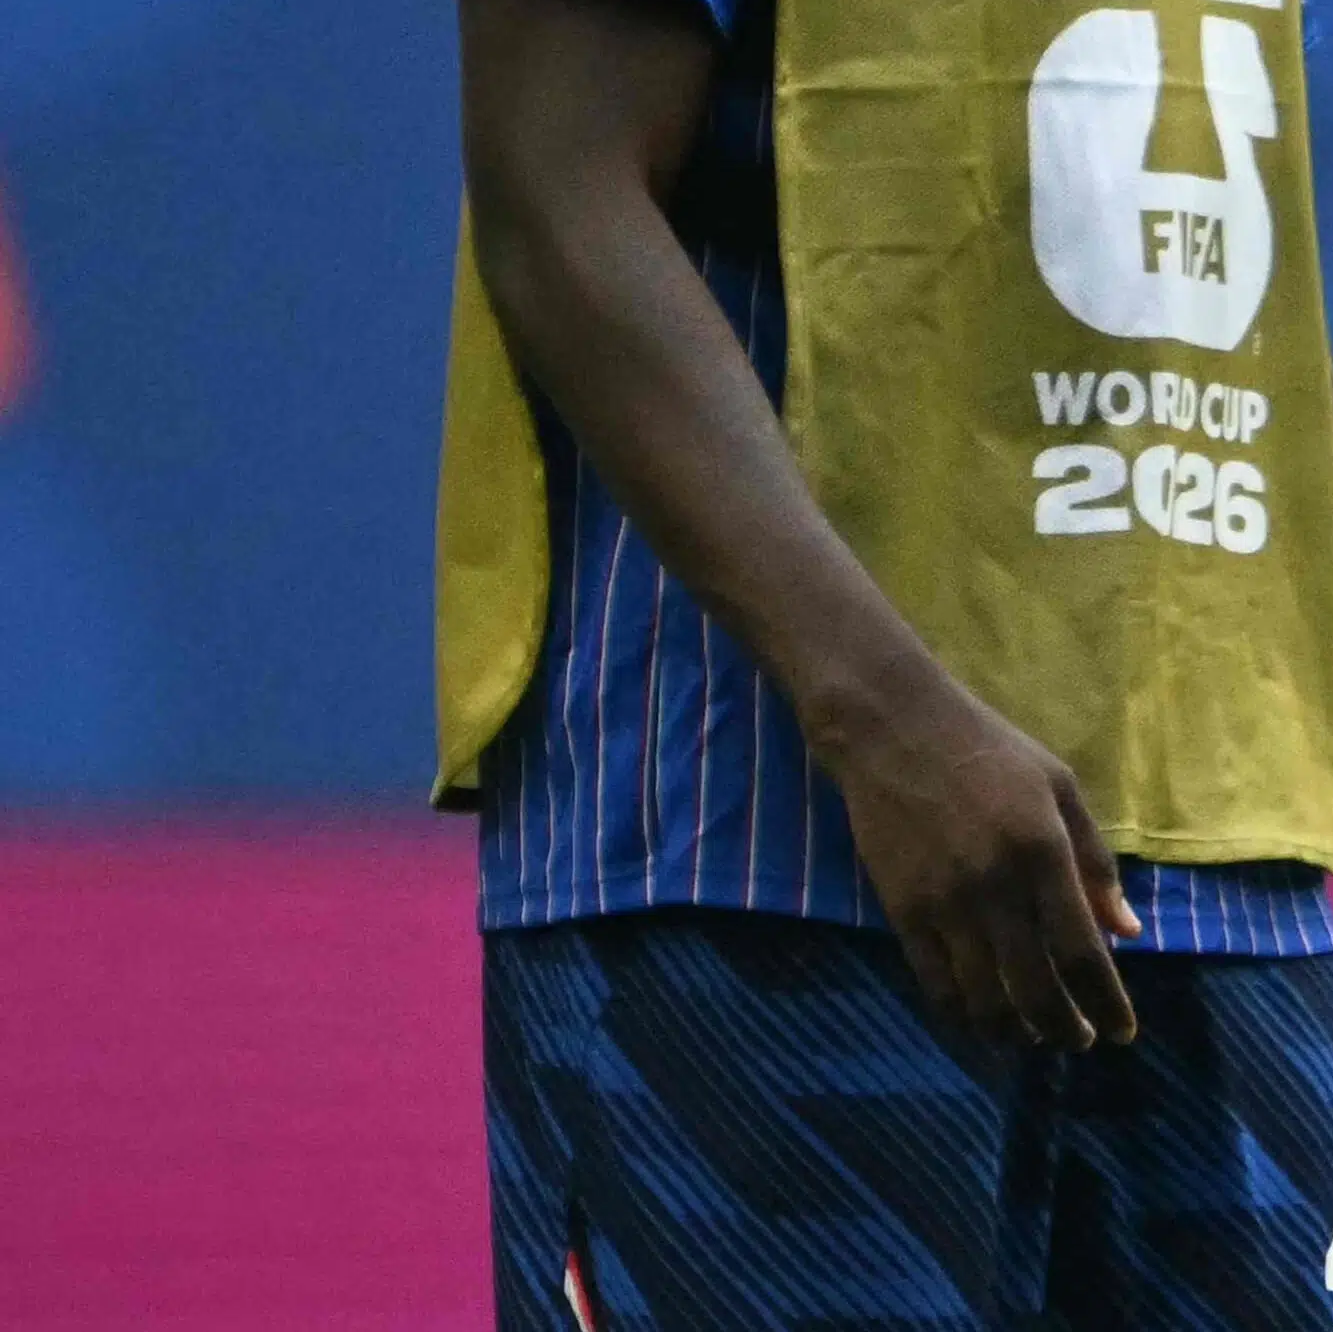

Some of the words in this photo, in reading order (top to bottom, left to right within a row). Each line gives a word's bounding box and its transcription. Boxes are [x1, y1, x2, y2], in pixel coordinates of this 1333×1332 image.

[1140, 209, 1227, 285] FIFA
[1200, 382, 1268, 444] CUP
[1032, 444, 1267, 554] 2026
